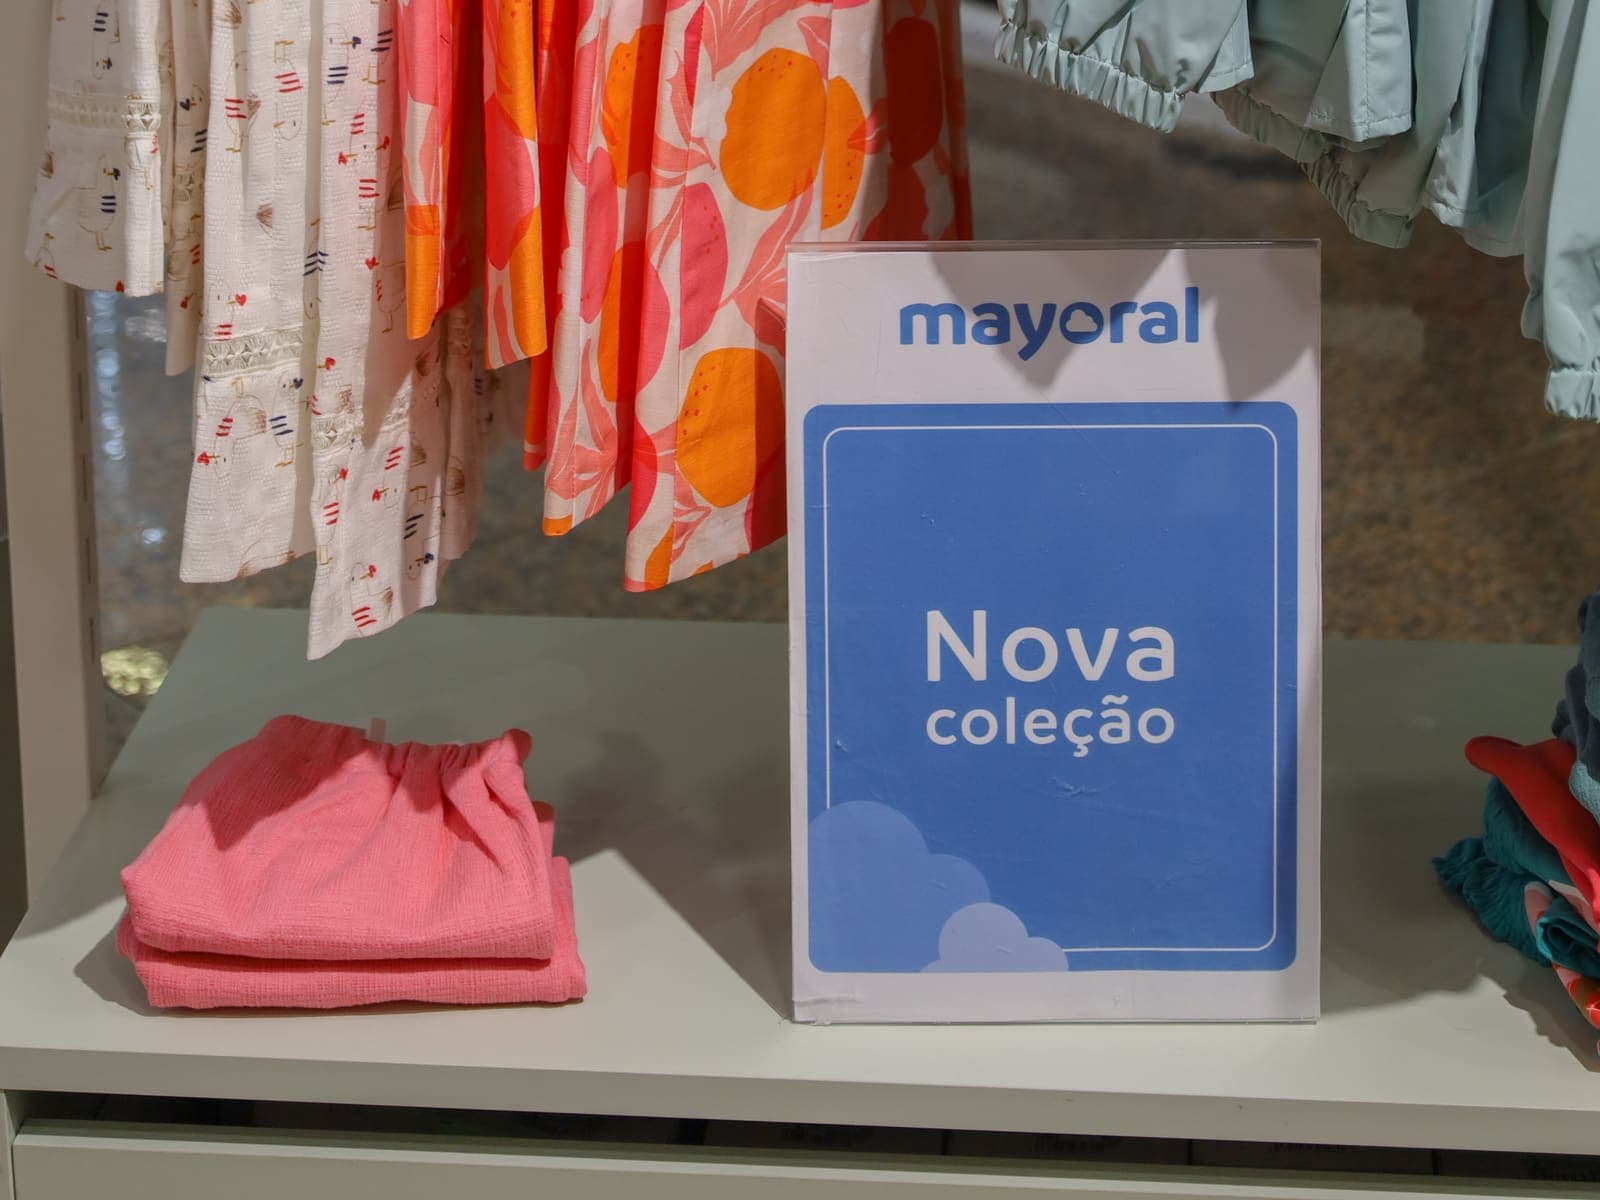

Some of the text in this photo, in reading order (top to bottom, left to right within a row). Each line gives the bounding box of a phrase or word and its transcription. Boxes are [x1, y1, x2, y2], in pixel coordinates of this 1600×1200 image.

[899, 286, 1200, 362] mayoral
[925, 608, 1176, 683] Nova
[925, 694, 1176, 758] coleção
